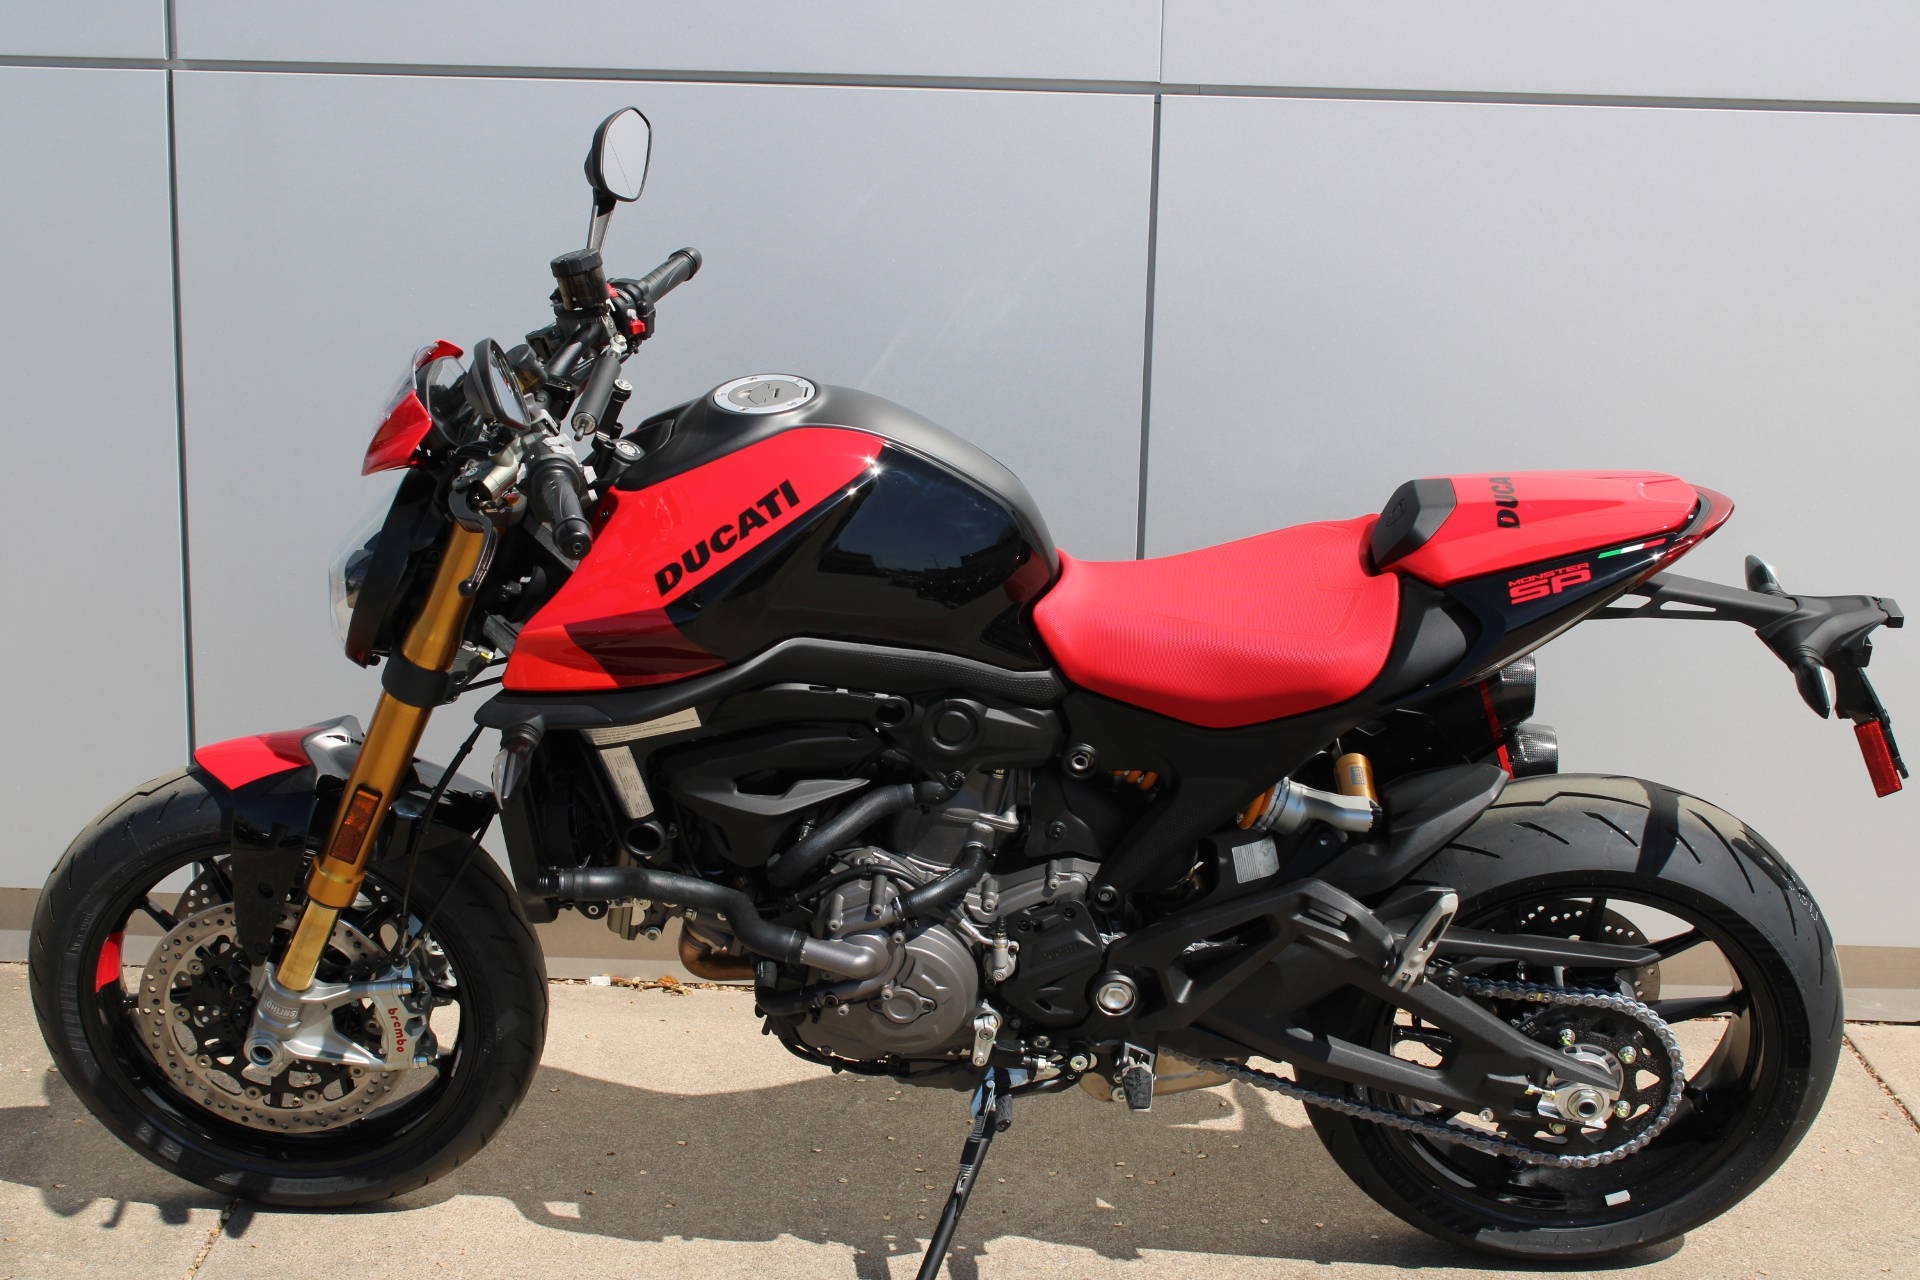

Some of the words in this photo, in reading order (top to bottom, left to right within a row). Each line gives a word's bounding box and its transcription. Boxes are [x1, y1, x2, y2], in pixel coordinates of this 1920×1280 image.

[654, 479, 800, 597] DUCATI
[1508, 562, 1590, 587] MONSTER
[1509, 569, 1592, 605] SP
[387, 1007, 408, 1053] brembo
